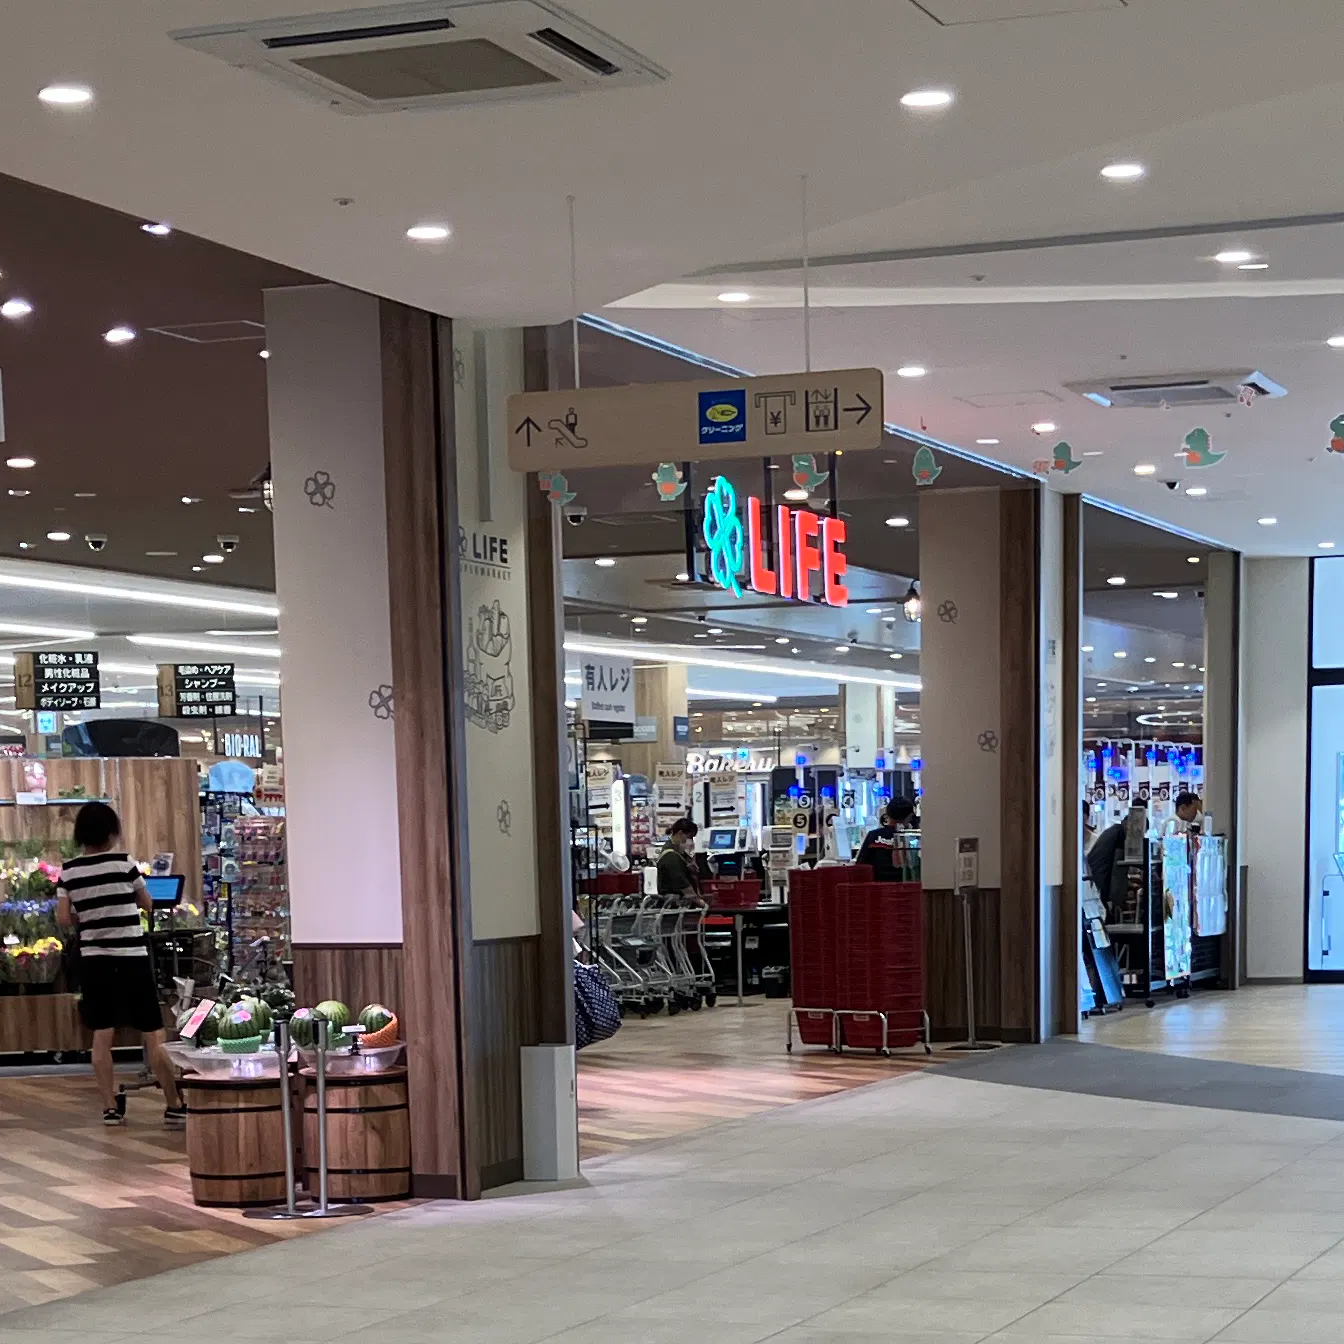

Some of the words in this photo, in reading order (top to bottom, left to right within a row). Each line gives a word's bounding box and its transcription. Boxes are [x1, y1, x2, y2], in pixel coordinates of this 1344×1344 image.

[701, 424, 743, 434] クリーニング
[473, 533, 508, 564] LIFE
[748, 496, 848, 607] LIFE
[460, 563, 511, 581] PERMARKET
[17, 674, 32, 687] 12
[44, 668, 90, 679] 男性化粧品
[584, 663, 630, 693] 有人レジ
[42, 683, 94, 693] メイクアップ
[184, 679, 226, 689] シャンプー
[224, 733, 262, 758] BIO-RAL
[686, 752, 775, 774] Bakery
[695, 791, 703, 803] 2
